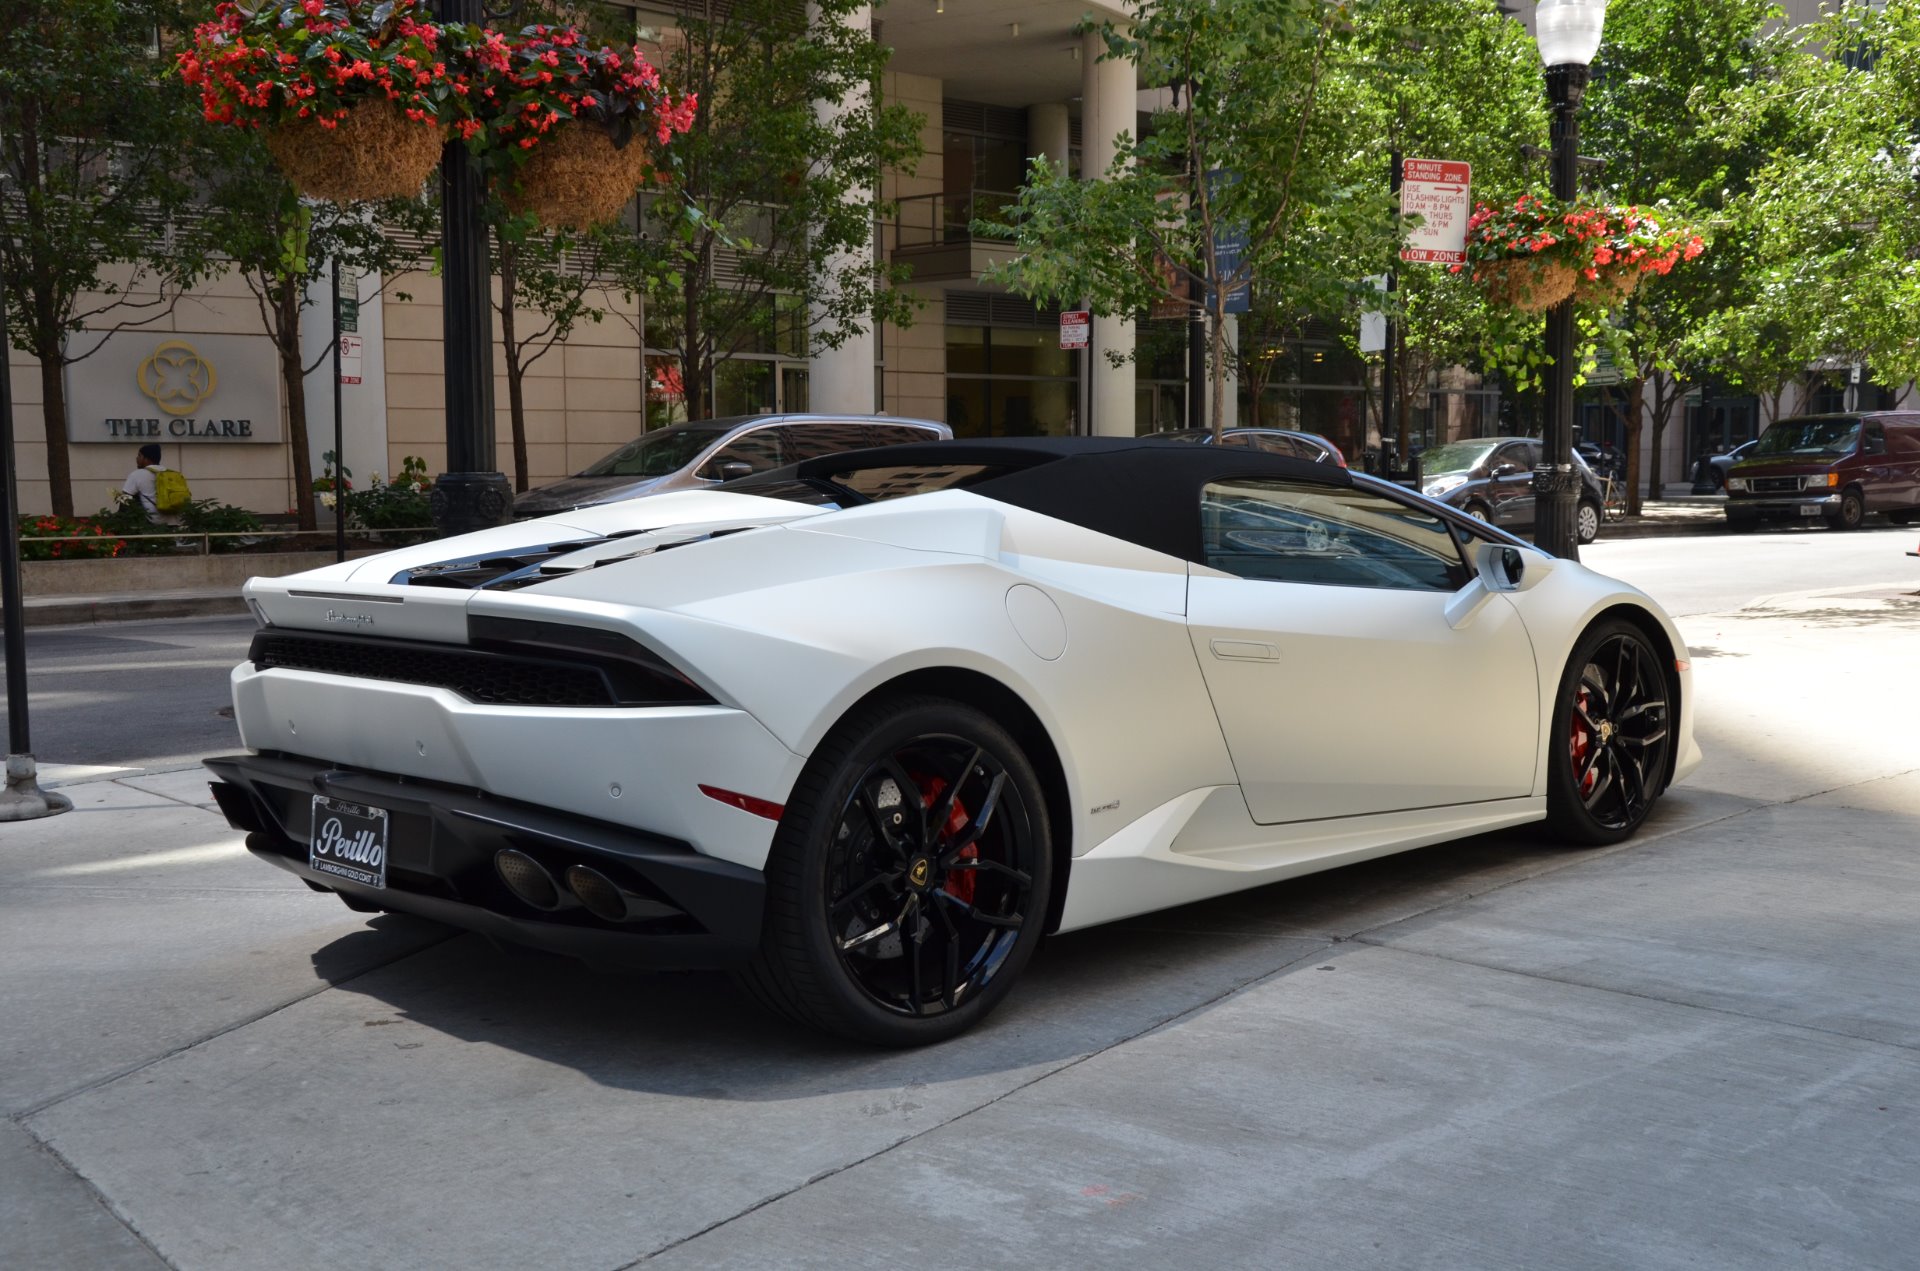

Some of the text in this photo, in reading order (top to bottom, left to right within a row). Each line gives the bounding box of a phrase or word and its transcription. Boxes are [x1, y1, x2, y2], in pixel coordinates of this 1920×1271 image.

[1408, 162, 1442, 172] 15 MINUTE
[1408, 171, 1462, 182] STANDING ZONE
[1407, 193, 1465, 204] FLASHING LIGHTS
[1430, 211, 1453, 220] THURS
[1406, 249, 1460, 261] TOW ZONE
[105, 418, 253, 437] THE CLARE
[316, 817, 382, 867] Perillo
[320, 862, 372, 883] LAMBORGHINI GOLD COAST
